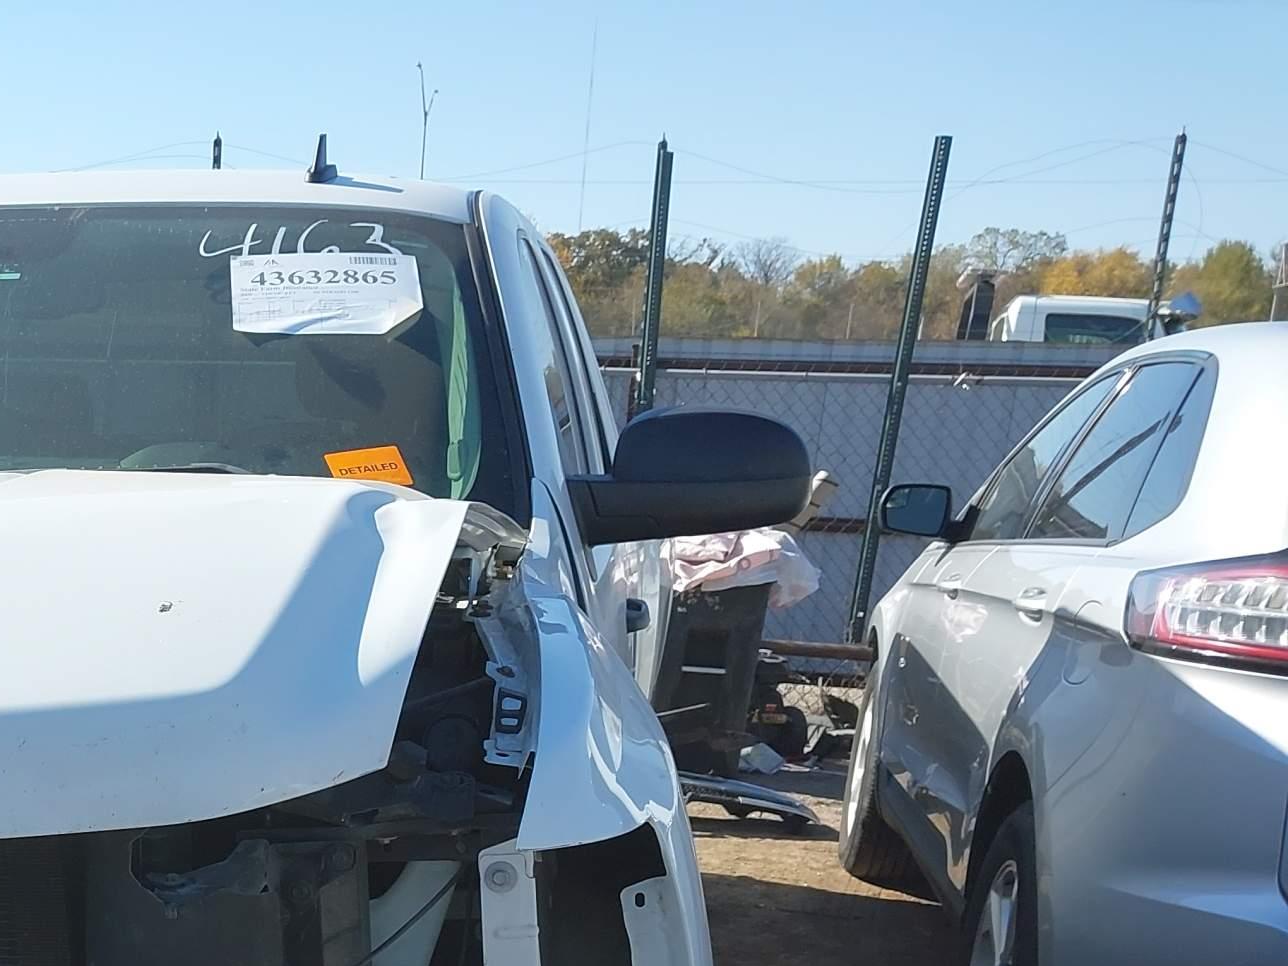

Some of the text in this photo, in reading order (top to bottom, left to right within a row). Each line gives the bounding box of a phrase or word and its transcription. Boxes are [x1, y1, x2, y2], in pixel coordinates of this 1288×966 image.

[199, 219, 403, 257] 4163
[250, 268, 397, 286] 43632865
[339, 462, 399, 476] DETAILED
